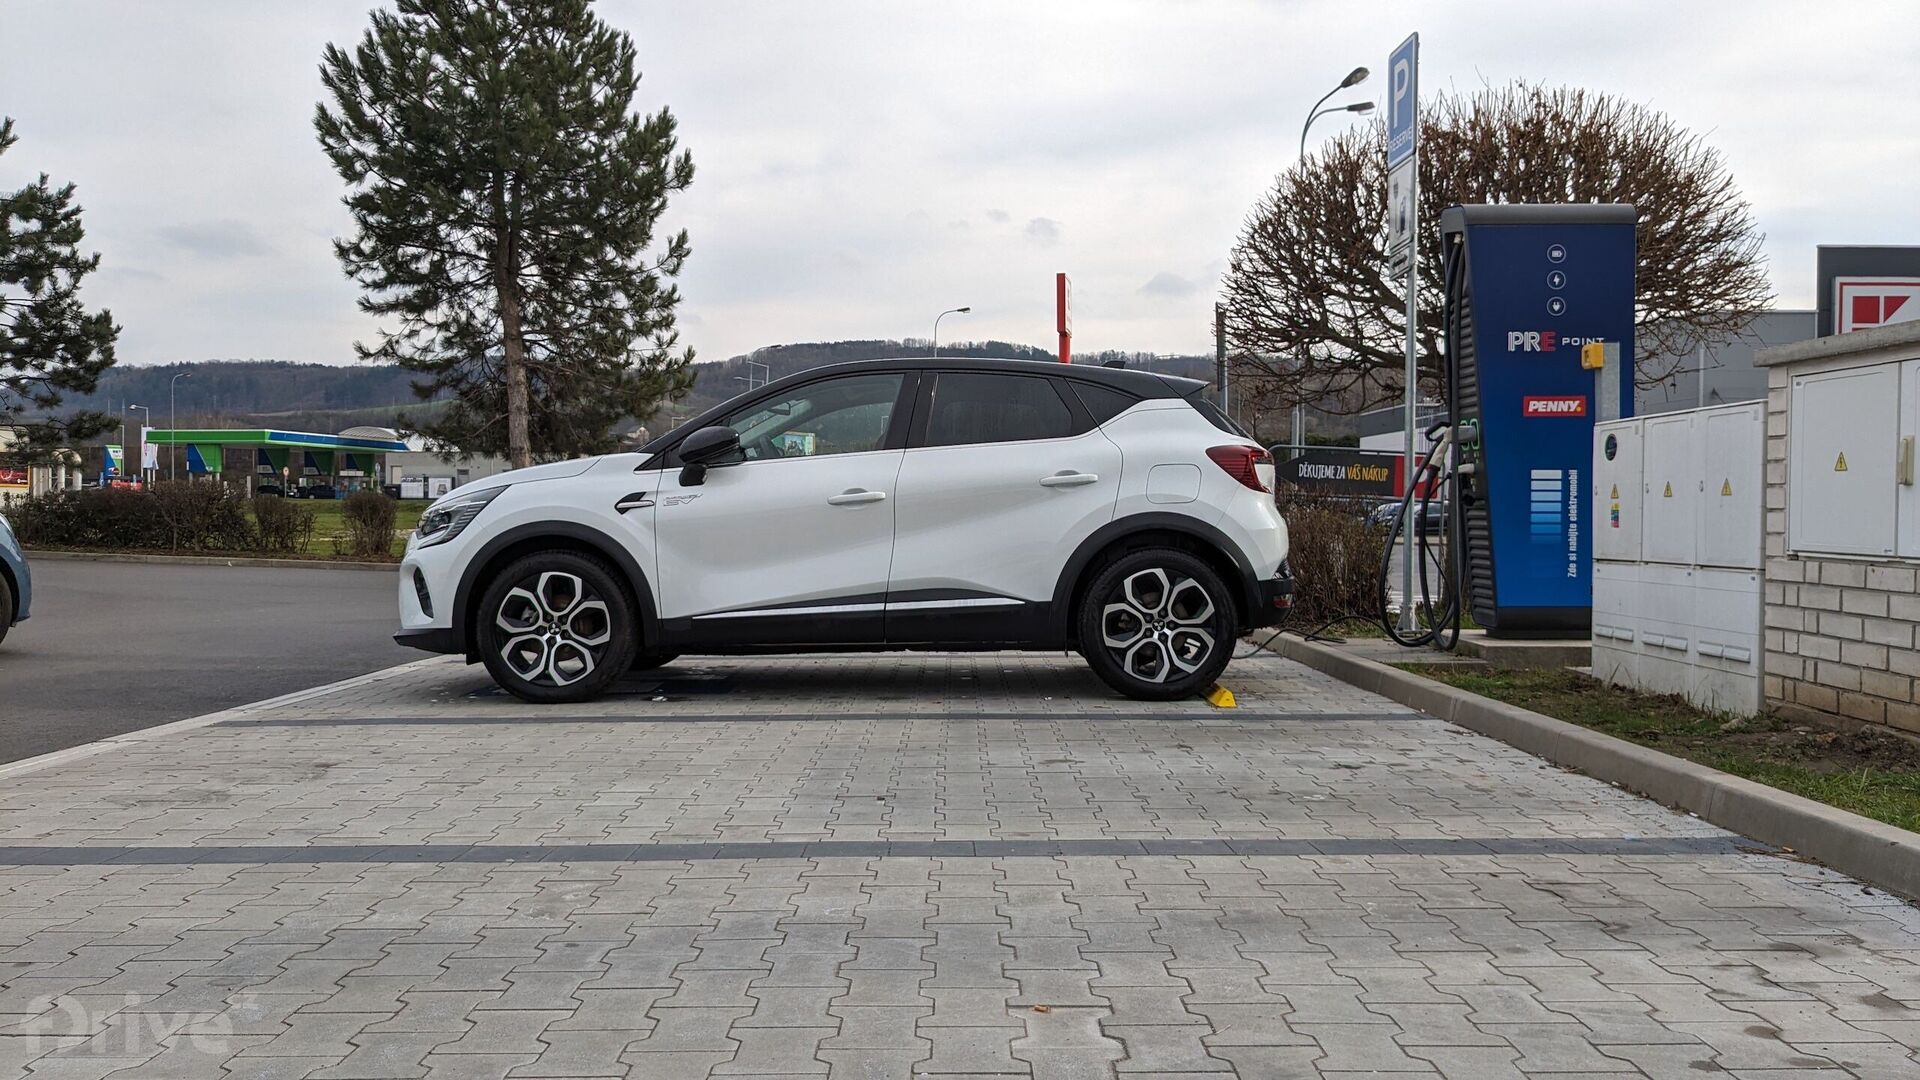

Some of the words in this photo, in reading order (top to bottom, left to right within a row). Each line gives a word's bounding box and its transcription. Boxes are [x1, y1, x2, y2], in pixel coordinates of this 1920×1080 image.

[1394, 58, 1409, 128] P
[1508, 331, 1556, 352] PRE
[1562, 338, 1604, 346] POINT
[1299, 462, 1335, 478] DĚKUJEME
[1336, 465, 1345, 479] ZA
[1347, 463, 1361, 481] VÁŠ
[1362, 464, 1388, 481] NÁKUP
[1568, 469, 1578, 521] elektromobil
[1567, 553, 1577, 561] si
[1567, 563, 1577, 578] Zde
